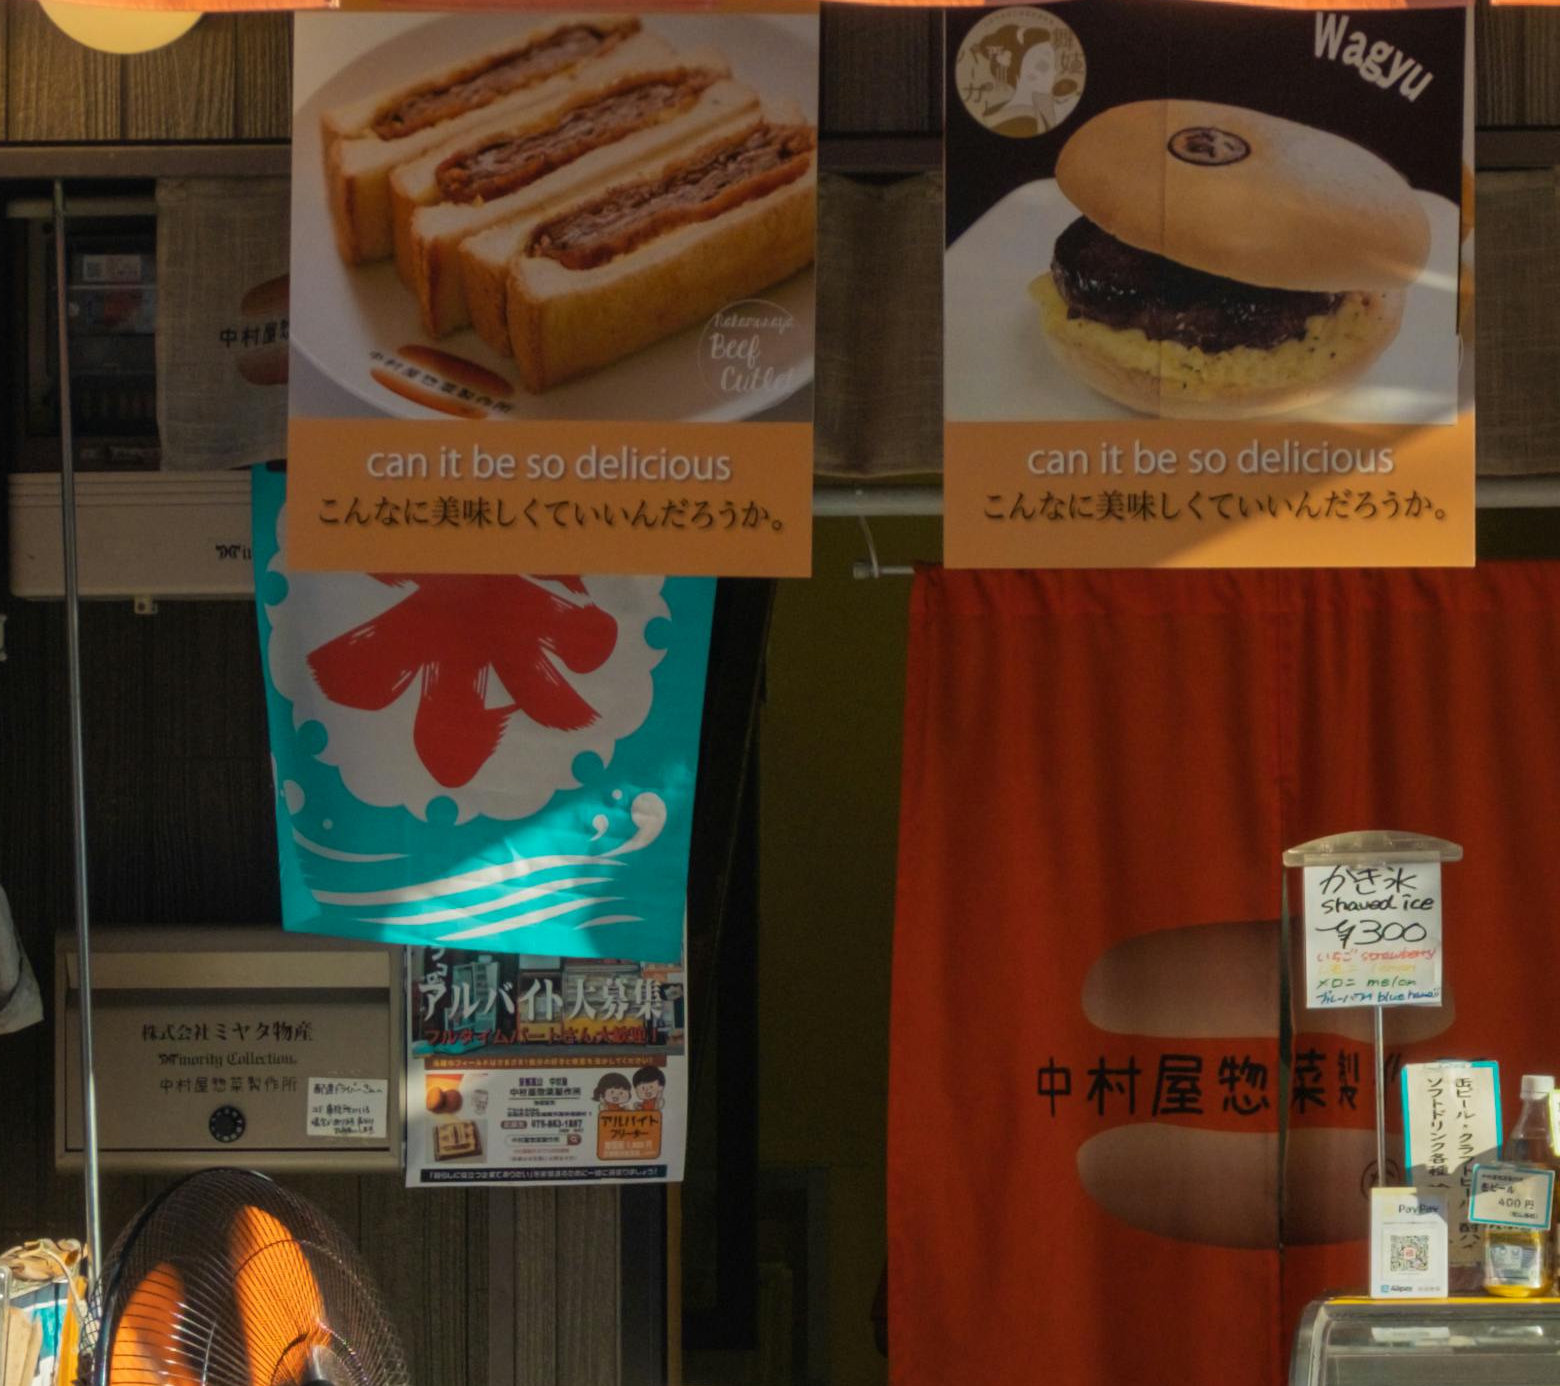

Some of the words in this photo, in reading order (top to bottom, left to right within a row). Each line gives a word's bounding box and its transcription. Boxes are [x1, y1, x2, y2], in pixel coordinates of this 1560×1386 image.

[1314, 12, 1435, 102] Wagyu
[709, 331, 763, 360] Beef
[366, 450, 428, 481] can
[440, 445, 462, 480] it
[473, 445, 517, 481] be
[527, 453, 566, 481] so
[574, 445, 733, 483] delicious
[1027, 445, 1090, 477] can
[1100, 440, 1124, 476] it
[1132, 439, 1177, 476] be
[1186, 447, 1228, 476] so
[1237, 438, 1395, 475] delicious
[317, 496, 786, 532] こんなに美味しくていいんだろうか。
[981, 485, 1449, 526] こんなに美味しくていいんだろうか。
[1319, 864, 1418, 895] かき氷
[1321, 895, 1397, 914] shaved
[1403, 894, 1435, 911] ice
[418, 976, 666, 1023] アルバイト大募集
[159, 1076, 298, 1094] 中村屋惣菜製作所
[600, 1114, 659, 1128] アルバイト
[1398, 1203, 1441, 1215] PayPay
